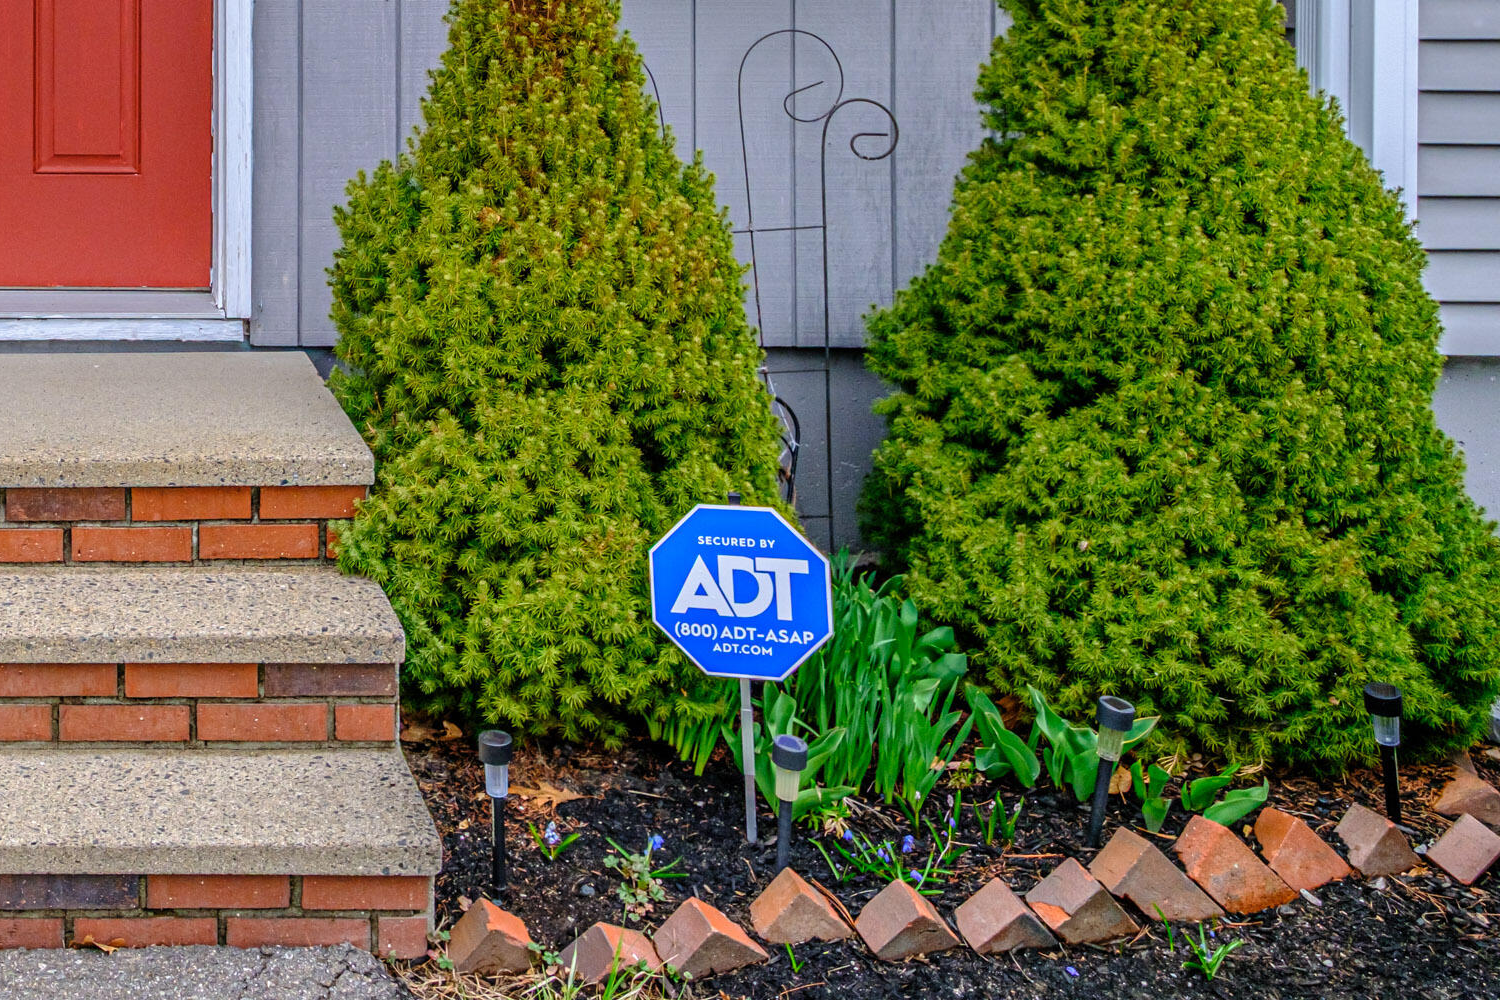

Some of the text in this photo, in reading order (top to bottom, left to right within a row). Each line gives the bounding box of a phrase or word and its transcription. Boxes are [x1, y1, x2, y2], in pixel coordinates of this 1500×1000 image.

[697, 535, 776, 549] SECURED BY
[670, 554, 810, 621] ADT
[674, 621, 814, 645] (800) ADT-ASAP
[712, 642, 773, 656] ADT.COM
